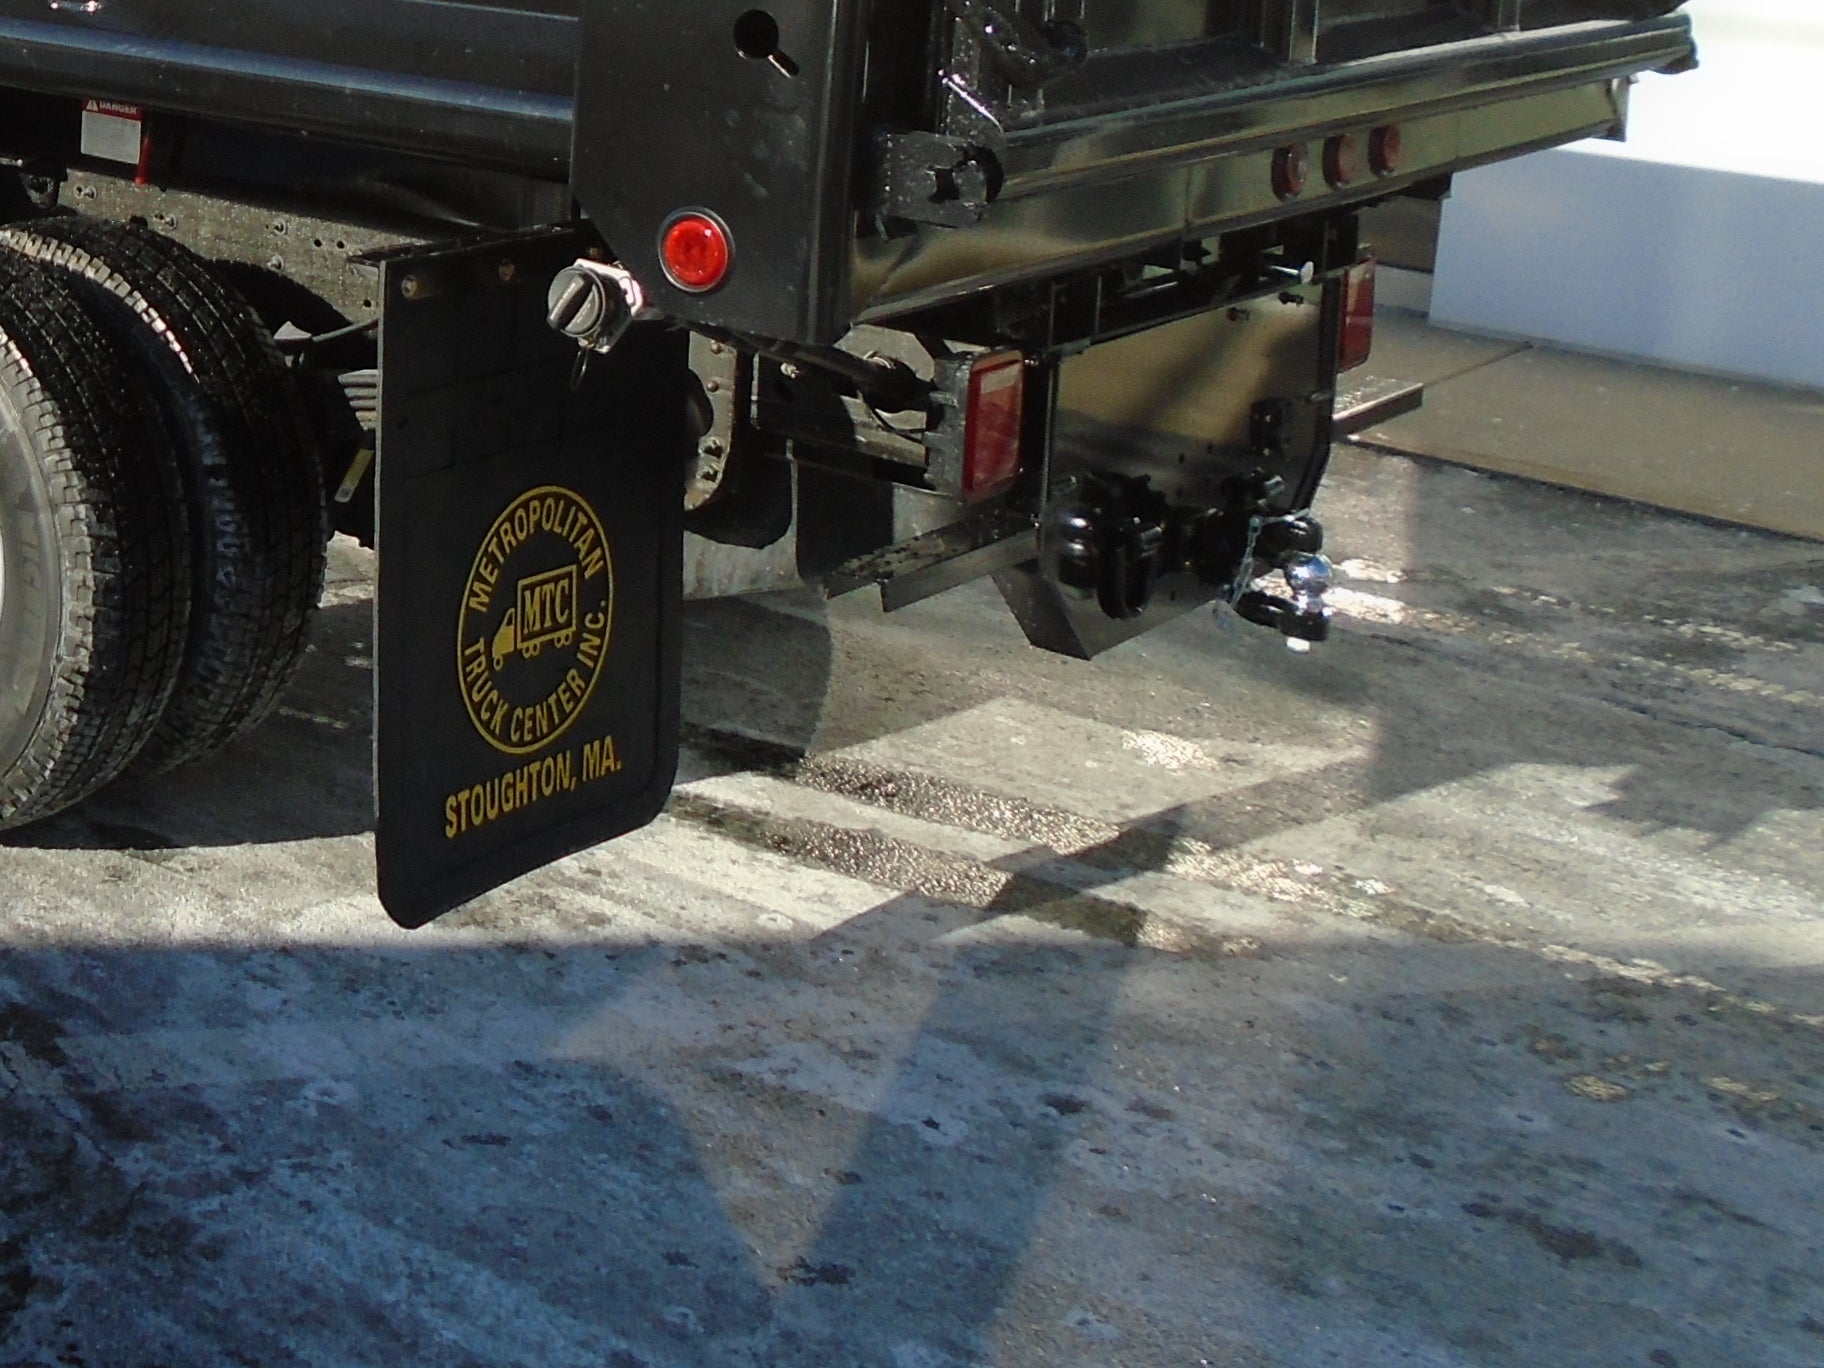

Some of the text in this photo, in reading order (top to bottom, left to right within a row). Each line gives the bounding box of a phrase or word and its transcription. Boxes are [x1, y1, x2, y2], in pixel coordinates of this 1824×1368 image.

[99, 100, 137, 114] DANGER
[469, 497, 605, 612] METROPOLITAN
[523, 578, 570, 633] MTC
[464, 599, 607, 743] TRUCK CENTER INC.
[445, 735, 622, 839] STOUGHTON, MA.
